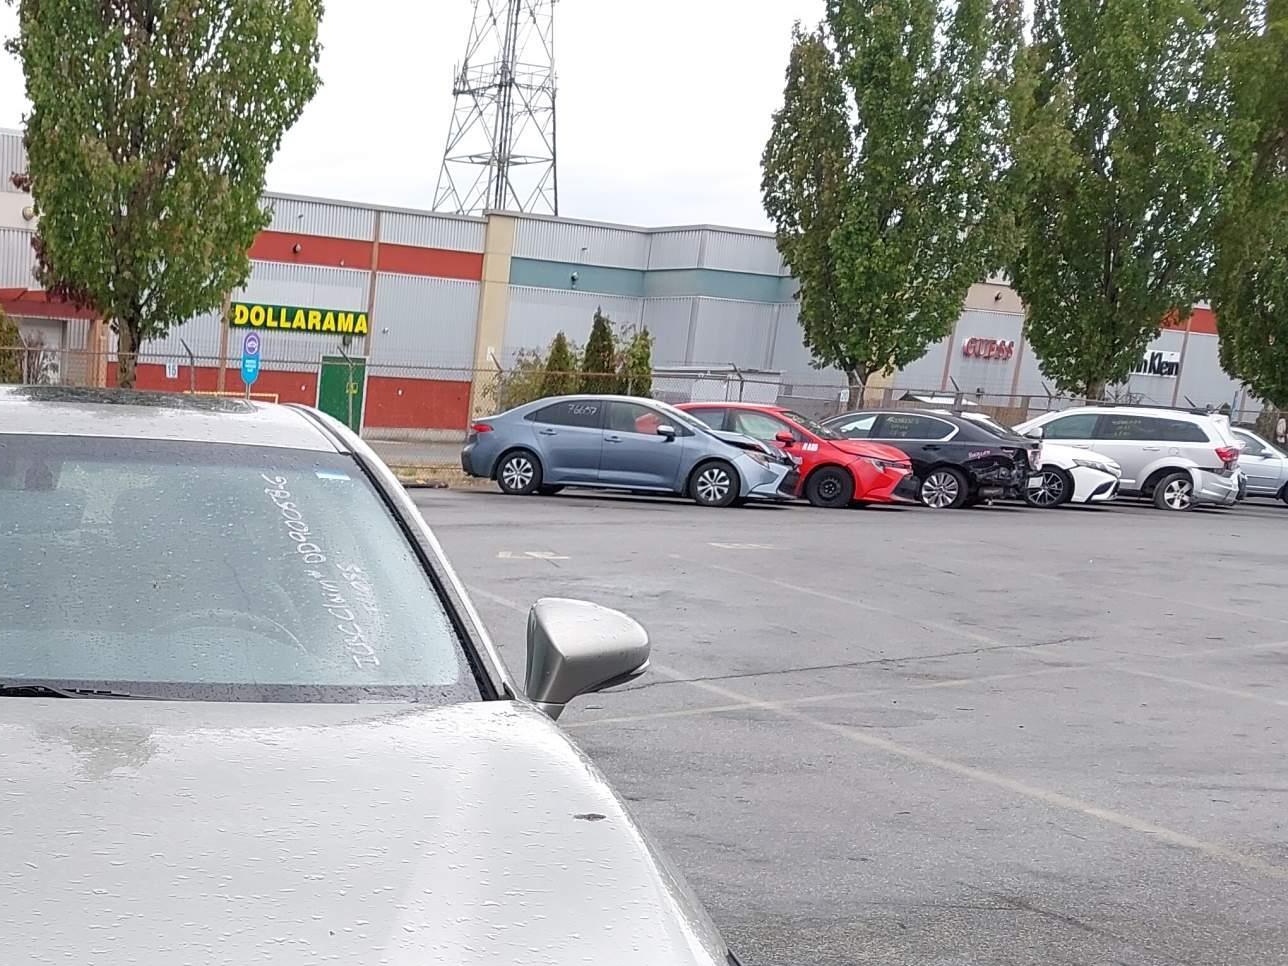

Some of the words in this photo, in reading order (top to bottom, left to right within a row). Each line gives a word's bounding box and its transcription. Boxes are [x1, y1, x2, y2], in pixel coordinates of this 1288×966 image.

[234, 303, 368, 334] DOLLARAMA
[1148, 351, 1180, 377] Klein
[320, 579, 355, 621] Claim
